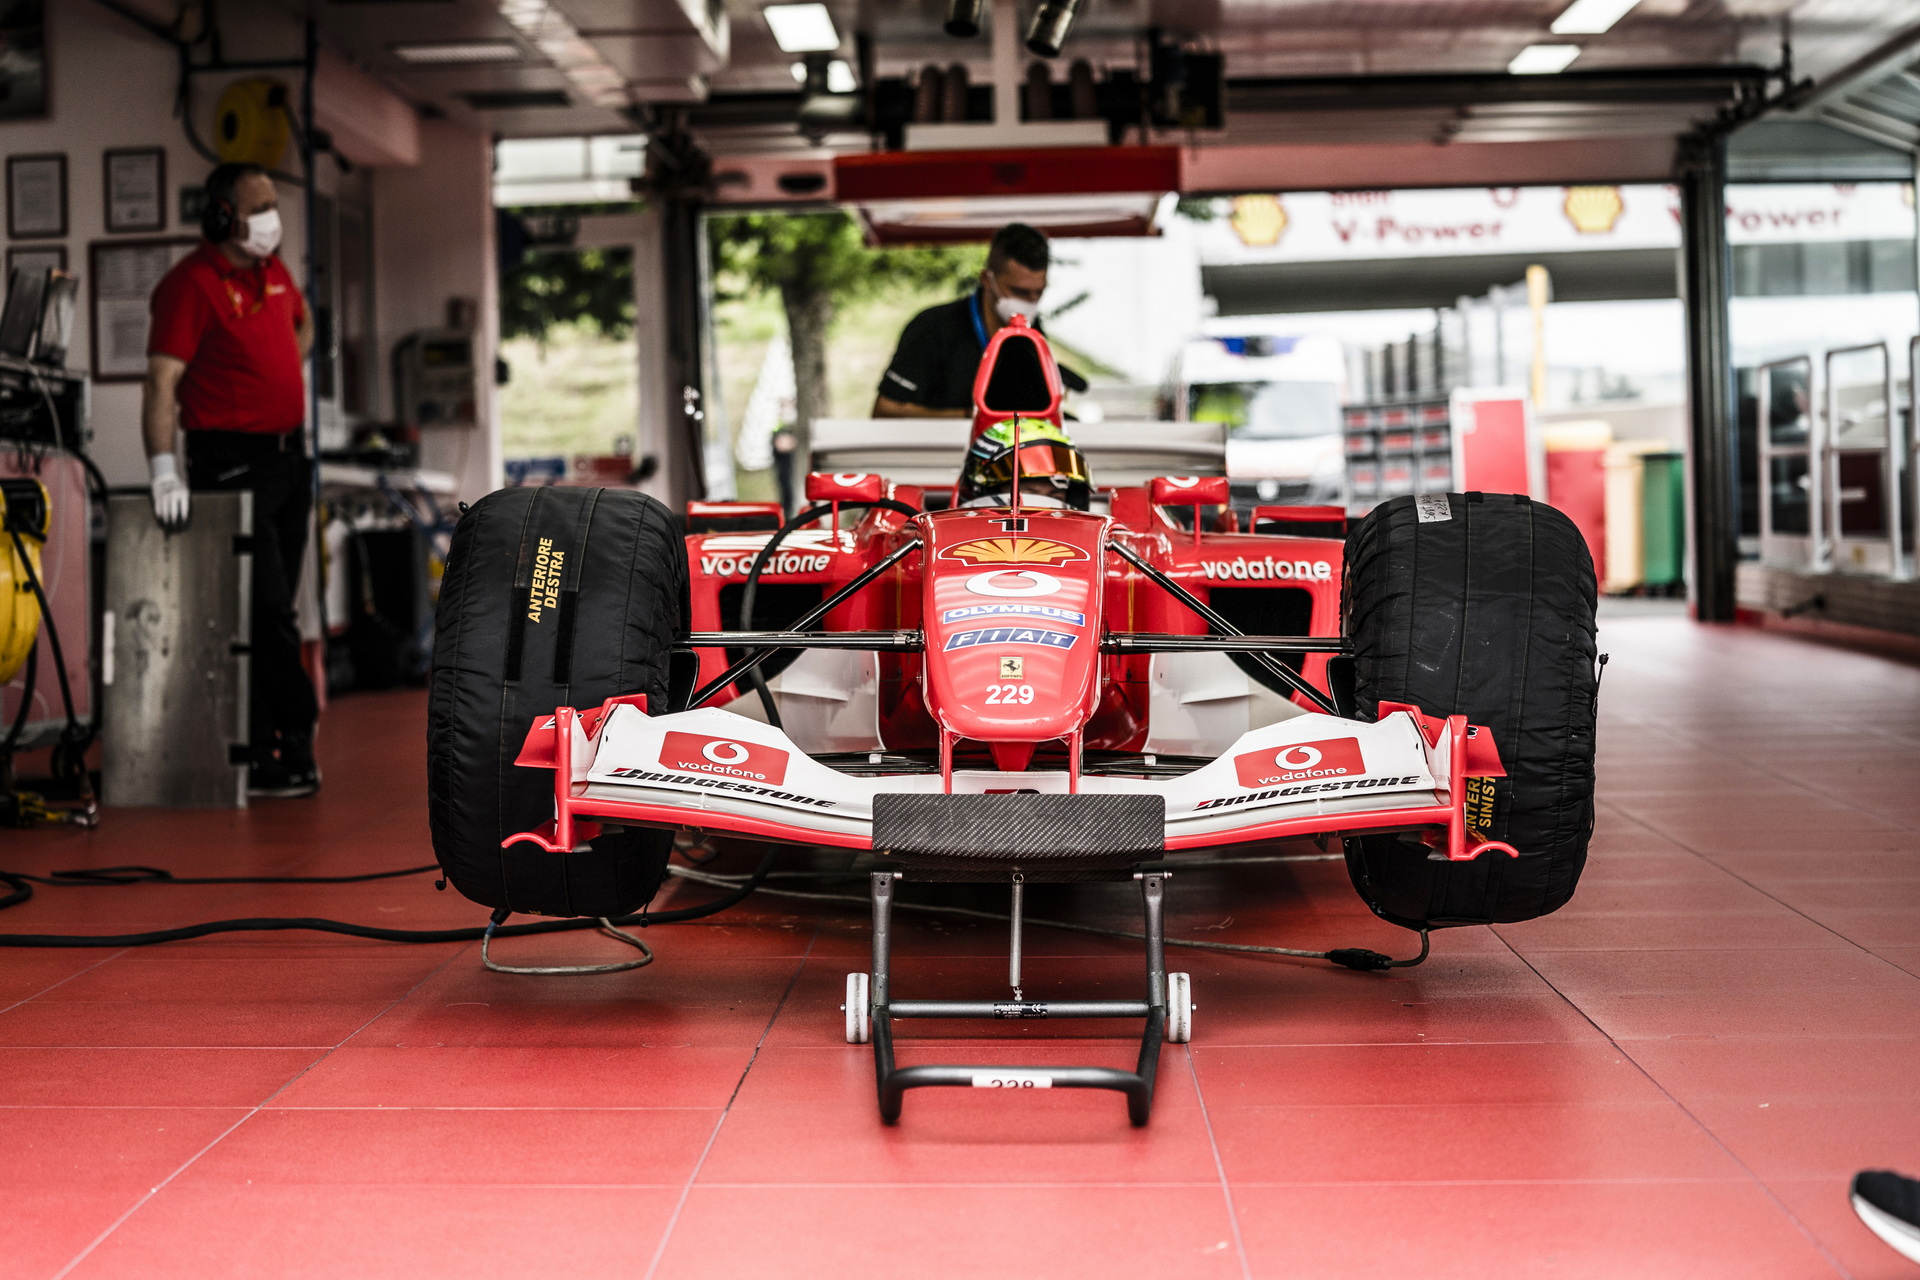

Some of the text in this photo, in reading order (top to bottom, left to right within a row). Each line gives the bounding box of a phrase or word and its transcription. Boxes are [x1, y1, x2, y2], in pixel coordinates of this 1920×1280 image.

[701, 552, 831, 577] vodafone
[1200, 556, 1332, 580] vodafone
[528, 537, 553, 624] ANTERIORE
[544, 551, 565, 609] DESTRA
[949, 605, 1081, 621] OLYMPUS
[956, 630, 1069, 647] FIAT
[984, 684, 1035, 705] 229
[677, 760, 766, 781] vodafone
[1258, 766, 1348, 785] vodafone
[605, 768, 838, 808] BRIDGESTONE
[1192, 775, 1420, 811] BRIDGESTONE
[1478, 776, 1496, 828] SINIST
